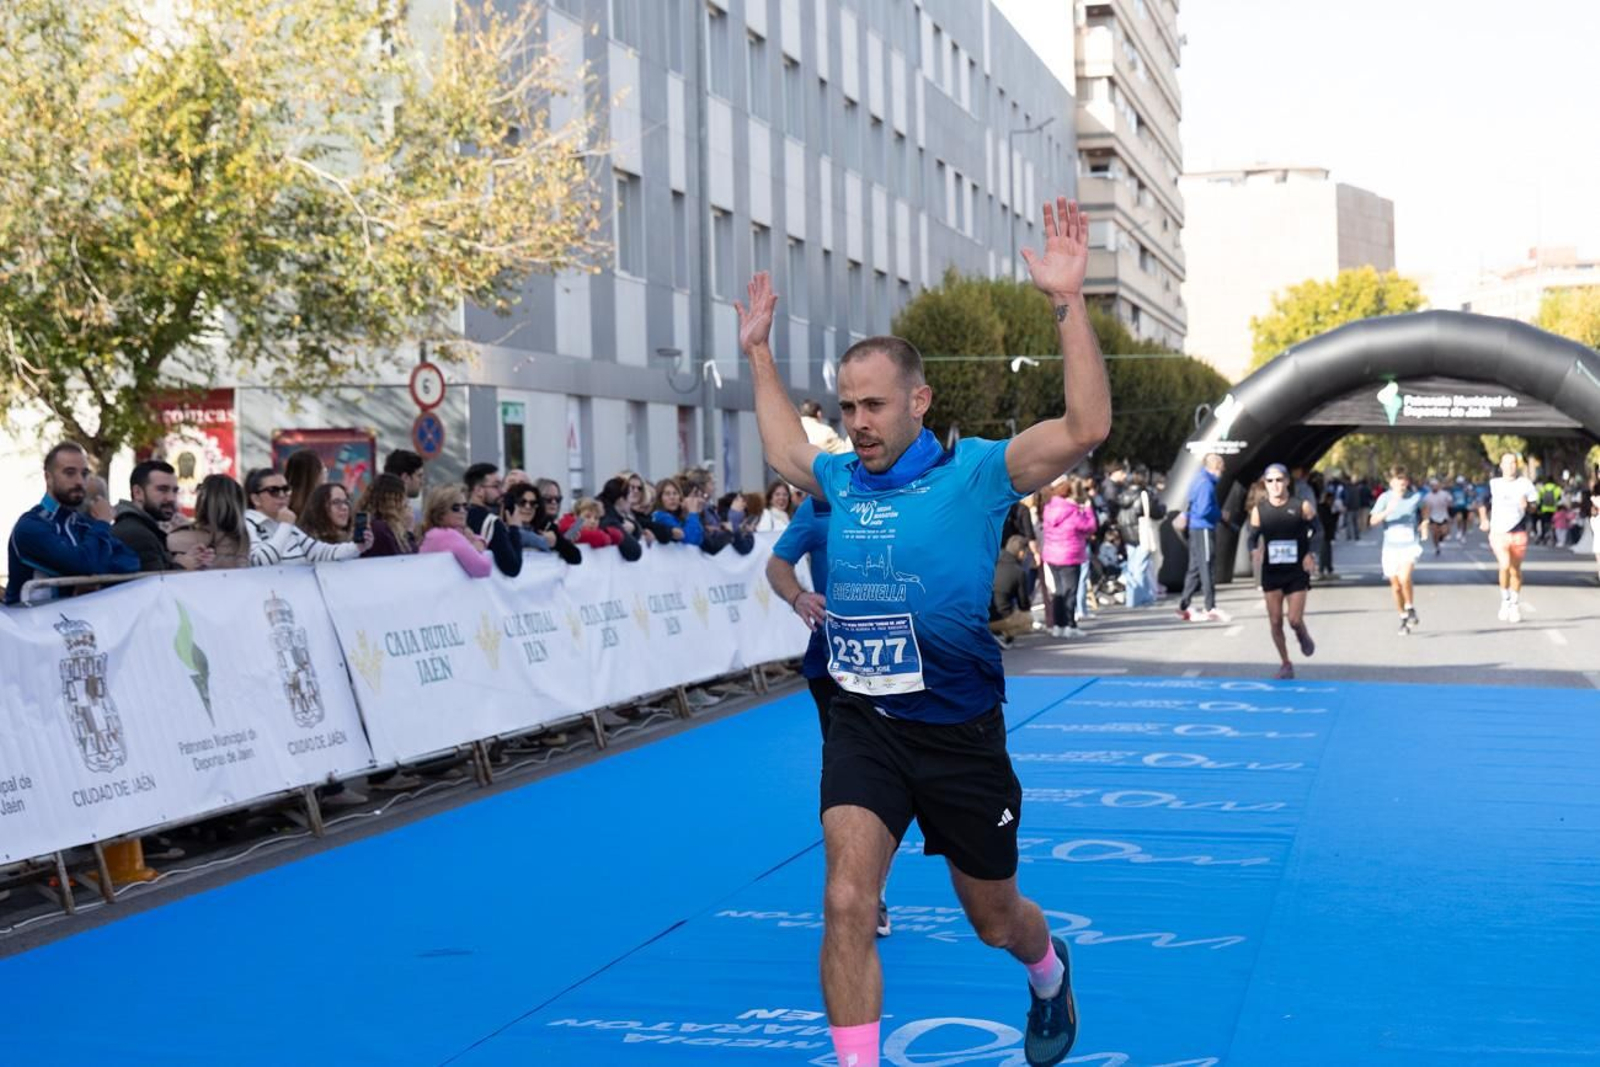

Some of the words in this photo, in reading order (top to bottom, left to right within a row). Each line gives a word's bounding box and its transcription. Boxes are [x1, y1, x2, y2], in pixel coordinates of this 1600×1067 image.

[385, 630, 421, 657] CAJA
[419, 623, 465, 652] RURAL
[833, 635, 907, 666] 2377
[416, 652, 453, 685] JAÉN
[19, 774, 33, 790] de
[72, 784, 113, 808] CIUDAD
[114, 780, 132, 798] DE
[132, 771, 158, 795] JAÉN
[0, 797, 26, 816] Jaén
[622, 1032, 827, 1050] MEDIA
